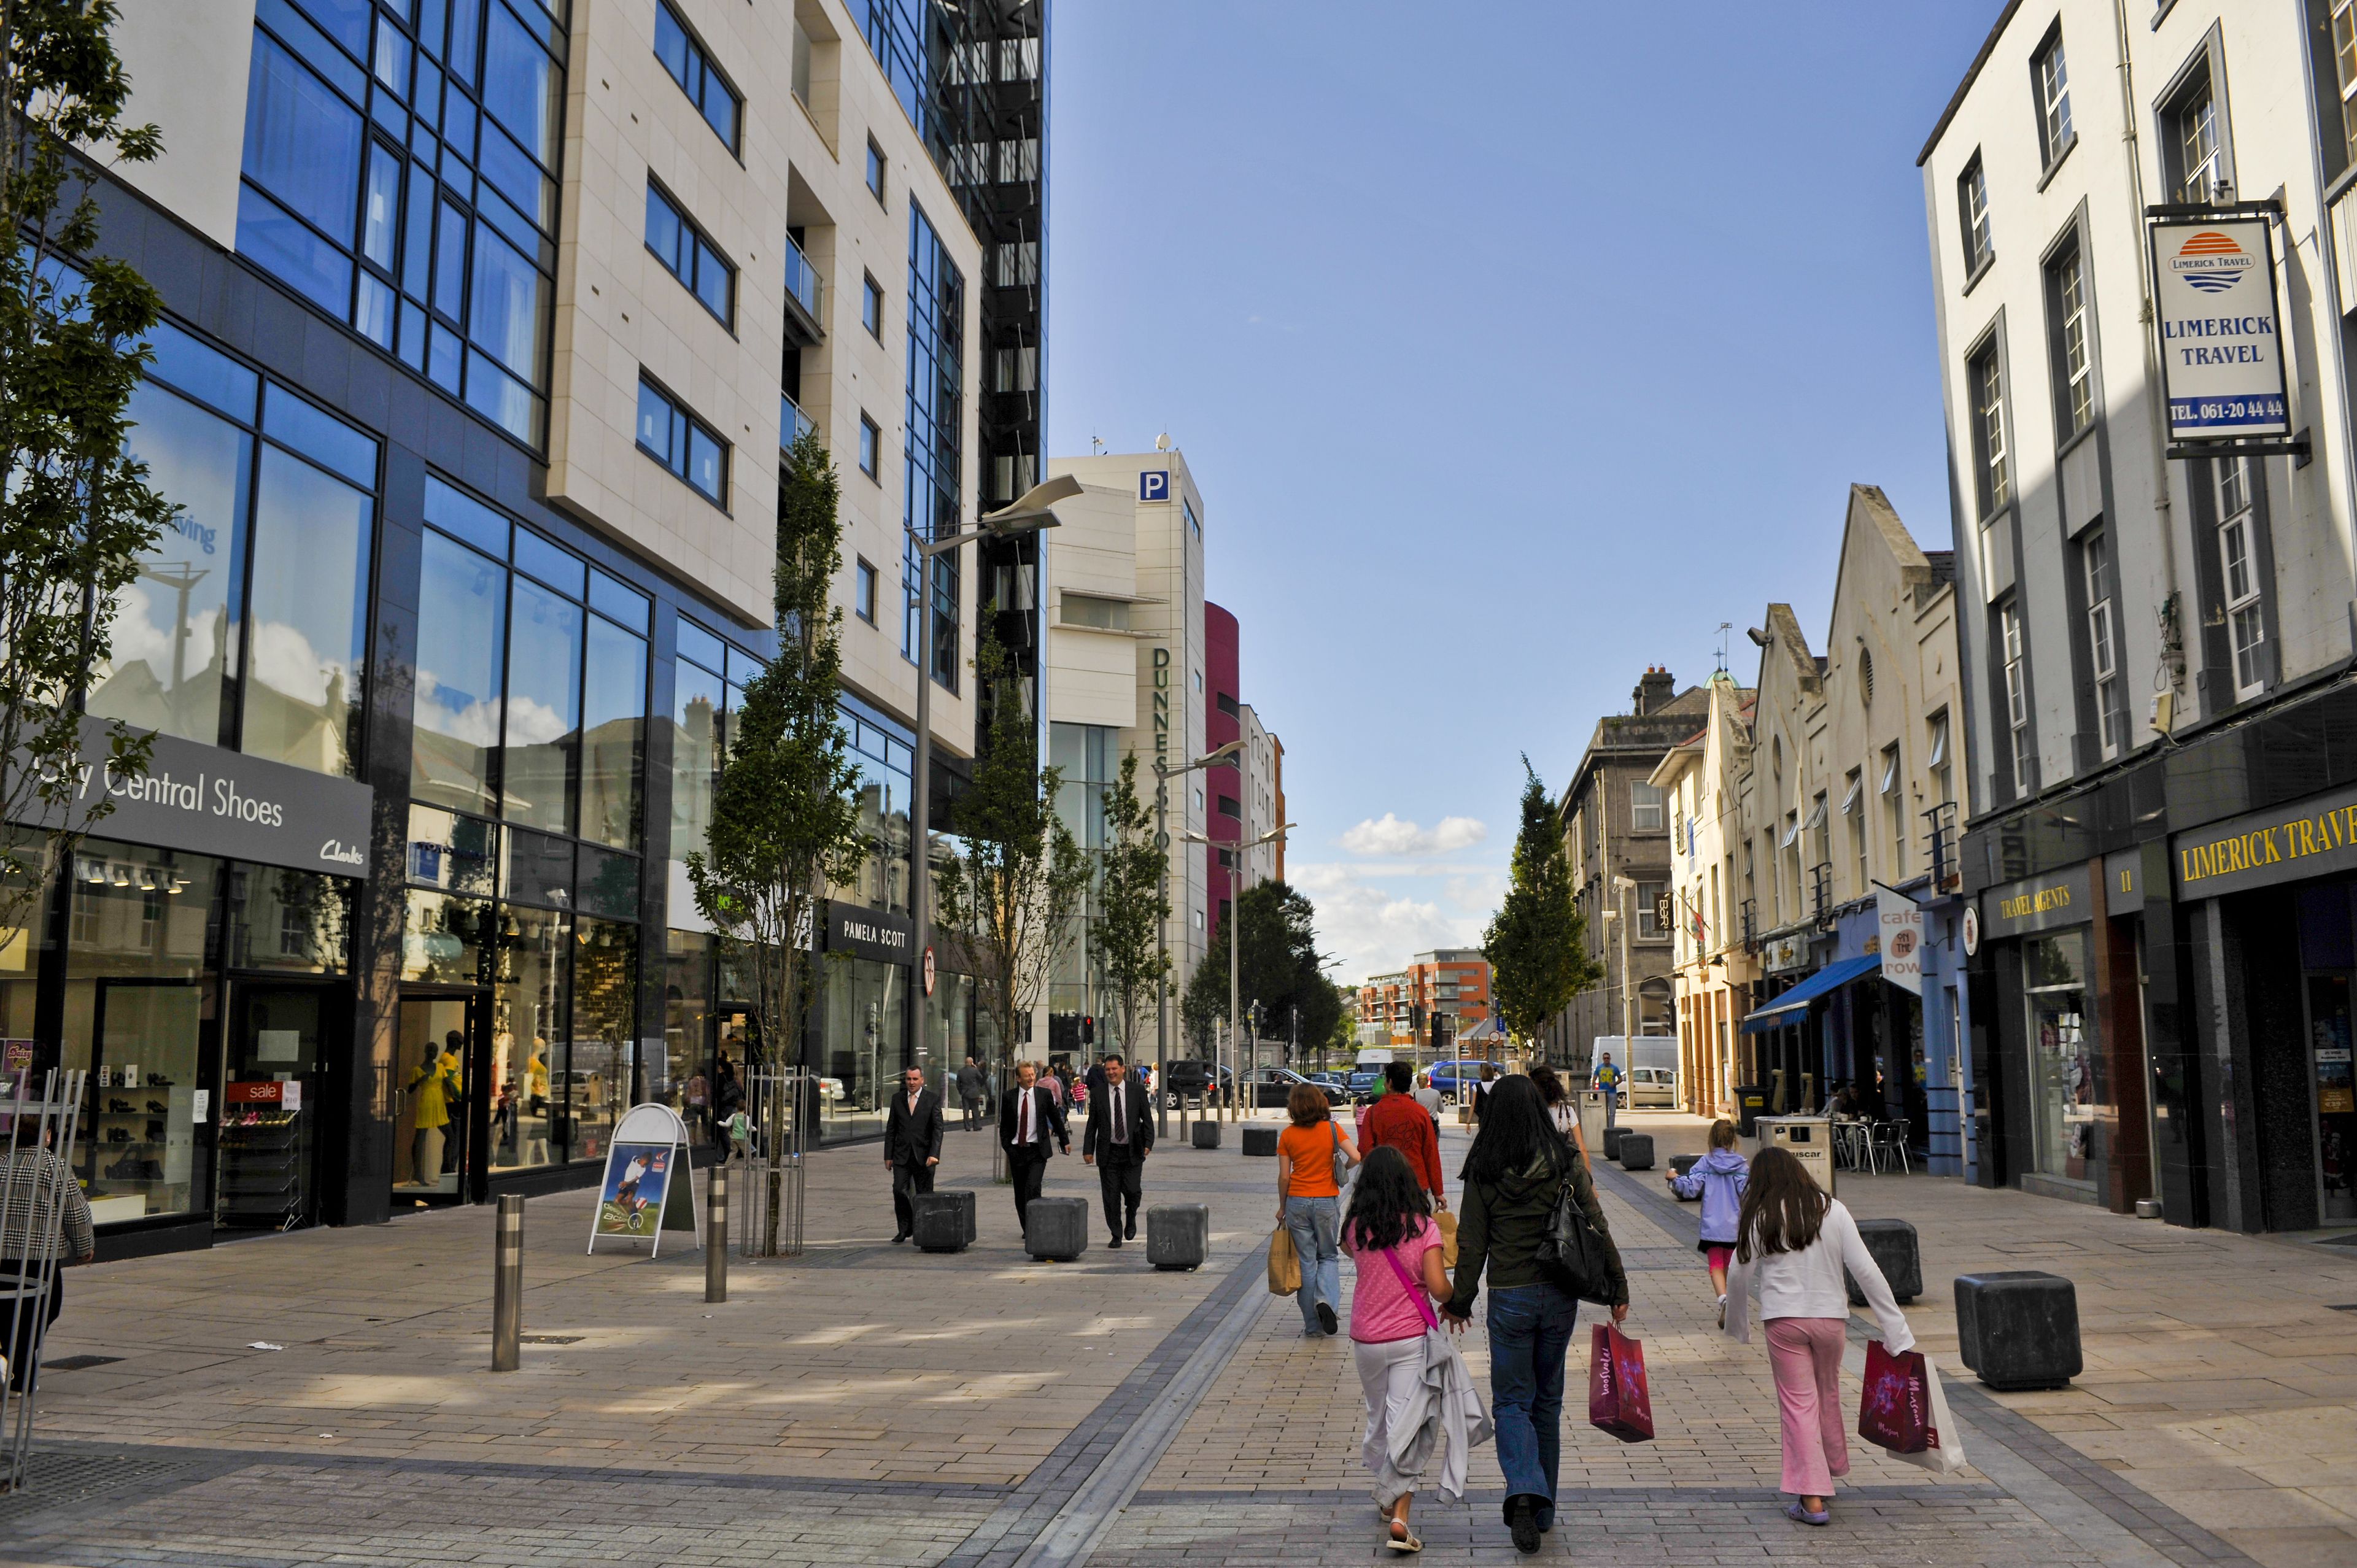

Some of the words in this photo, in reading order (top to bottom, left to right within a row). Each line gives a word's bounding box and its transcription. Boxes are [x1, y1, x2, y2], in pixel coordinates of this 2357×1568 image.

[2173, 259, 2215, 269] LIMERICK
[2217, 257, 2251, 266] TRAVEL
[2164, 316, 2273, 338] LIMERICK
[2181, 345, 2264, 365] TRAVEL
[2170, 405, 2198, 420] TEL.
[2200, 402, 2245, 419] 061-20
[1146, 474, 1163, 498] P
[1153, 648, 1170, 773] DUNNES
[104, 755, 204, 811] Central
[212, 778, 283, 827] Shoes
[320, 839, 363, 865] Clarks
[2181, 826, 2282, 882] LIMERICK
[2121, 869, 2132, 894] 11
[2000, 894, 2033, 919] TRAVEL
[2034, 884, 2070, 913] AGENTS
[1881, 909, 1922, 925] cafe
[844, 921, 877, 943] PAMELA
[881, 929, 905, 948] SCOTT
[1897, 933, 1909, 942] ON
[1897, 943, 1911, 953] THE
[1885, 962, 1922, 975] row
[250, 1084, 276, 1098] sale
[1909, 1377, 1921, 1427] Monsoon
